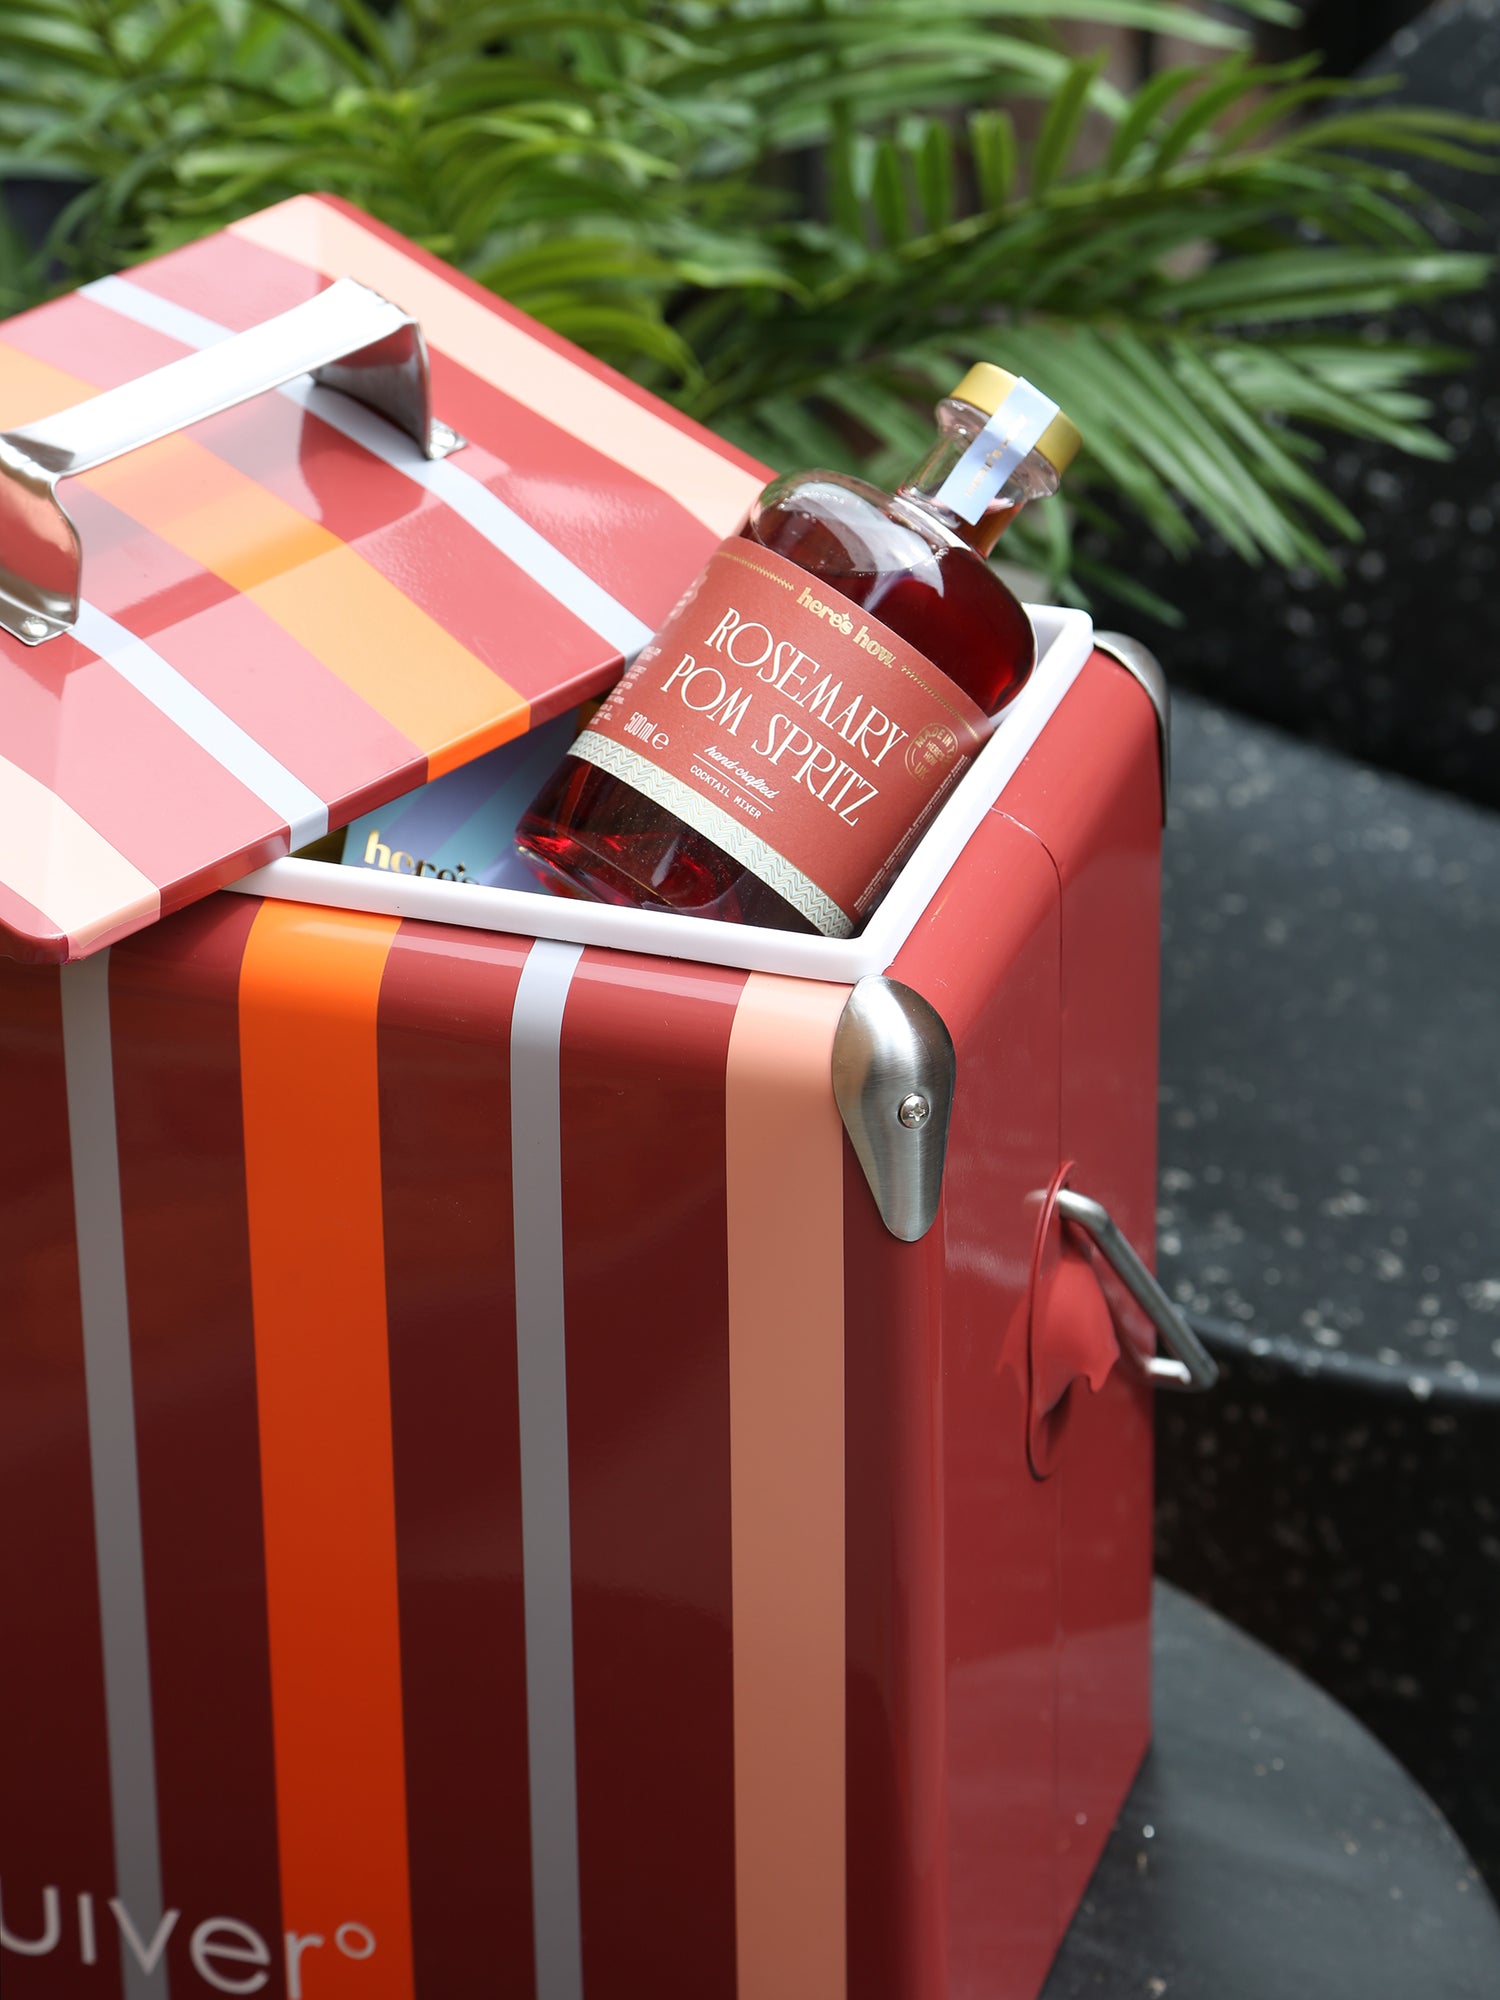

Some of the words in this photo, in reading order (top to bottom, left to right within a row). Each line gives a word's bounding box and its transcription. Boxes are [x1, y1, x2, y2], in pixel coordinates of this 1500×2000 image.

[796, 586, 854, 635] here's
[704, 607, 909, 768] ROSEMARY
[623, 711, 658, 743] 500ml
[660, 653, 753, 737] POM
[751, 713, 879, 827] SPRITZ
[689, 764, 731, 798] COCKTAIL
[733, 795, 762, 820] MIXER
[704, 745, 780, 799] hand-crafted
